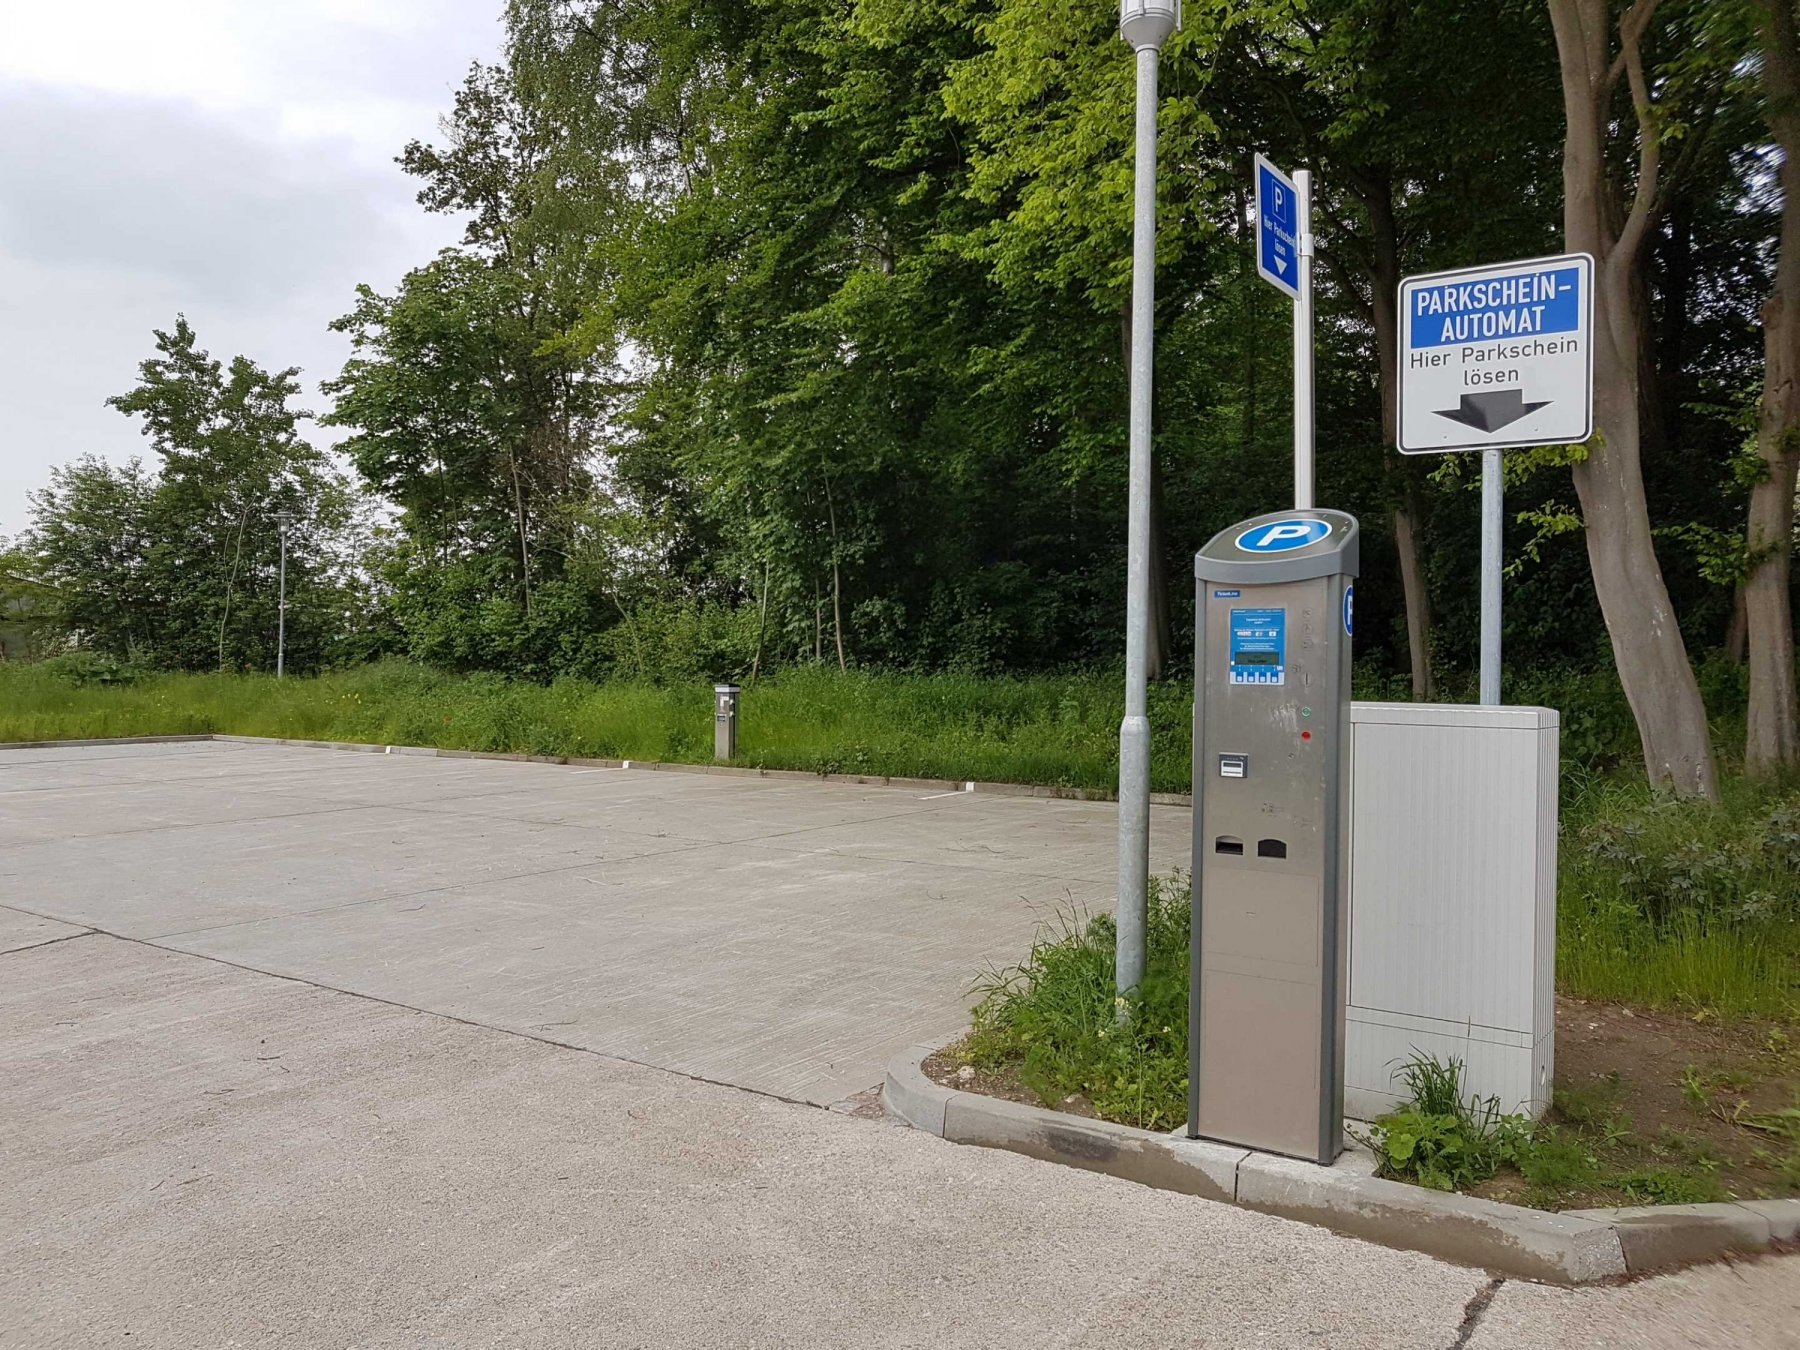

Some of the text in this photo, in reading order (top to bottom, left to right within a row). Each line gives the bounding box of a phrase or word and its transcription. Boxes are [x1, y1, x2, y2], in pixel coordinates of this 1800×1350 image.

[1275, 186, 1282, 212] P
[1417, 273, 1572, 317] PARKSCHEIN-
[1441, 305, 1546, 343] AUTOMAT
[1411, 336, 1578, 370] Hier Parkschein
[1464, 368, 1519, 386] lösen
[1256, 525, 1311, 547] P
